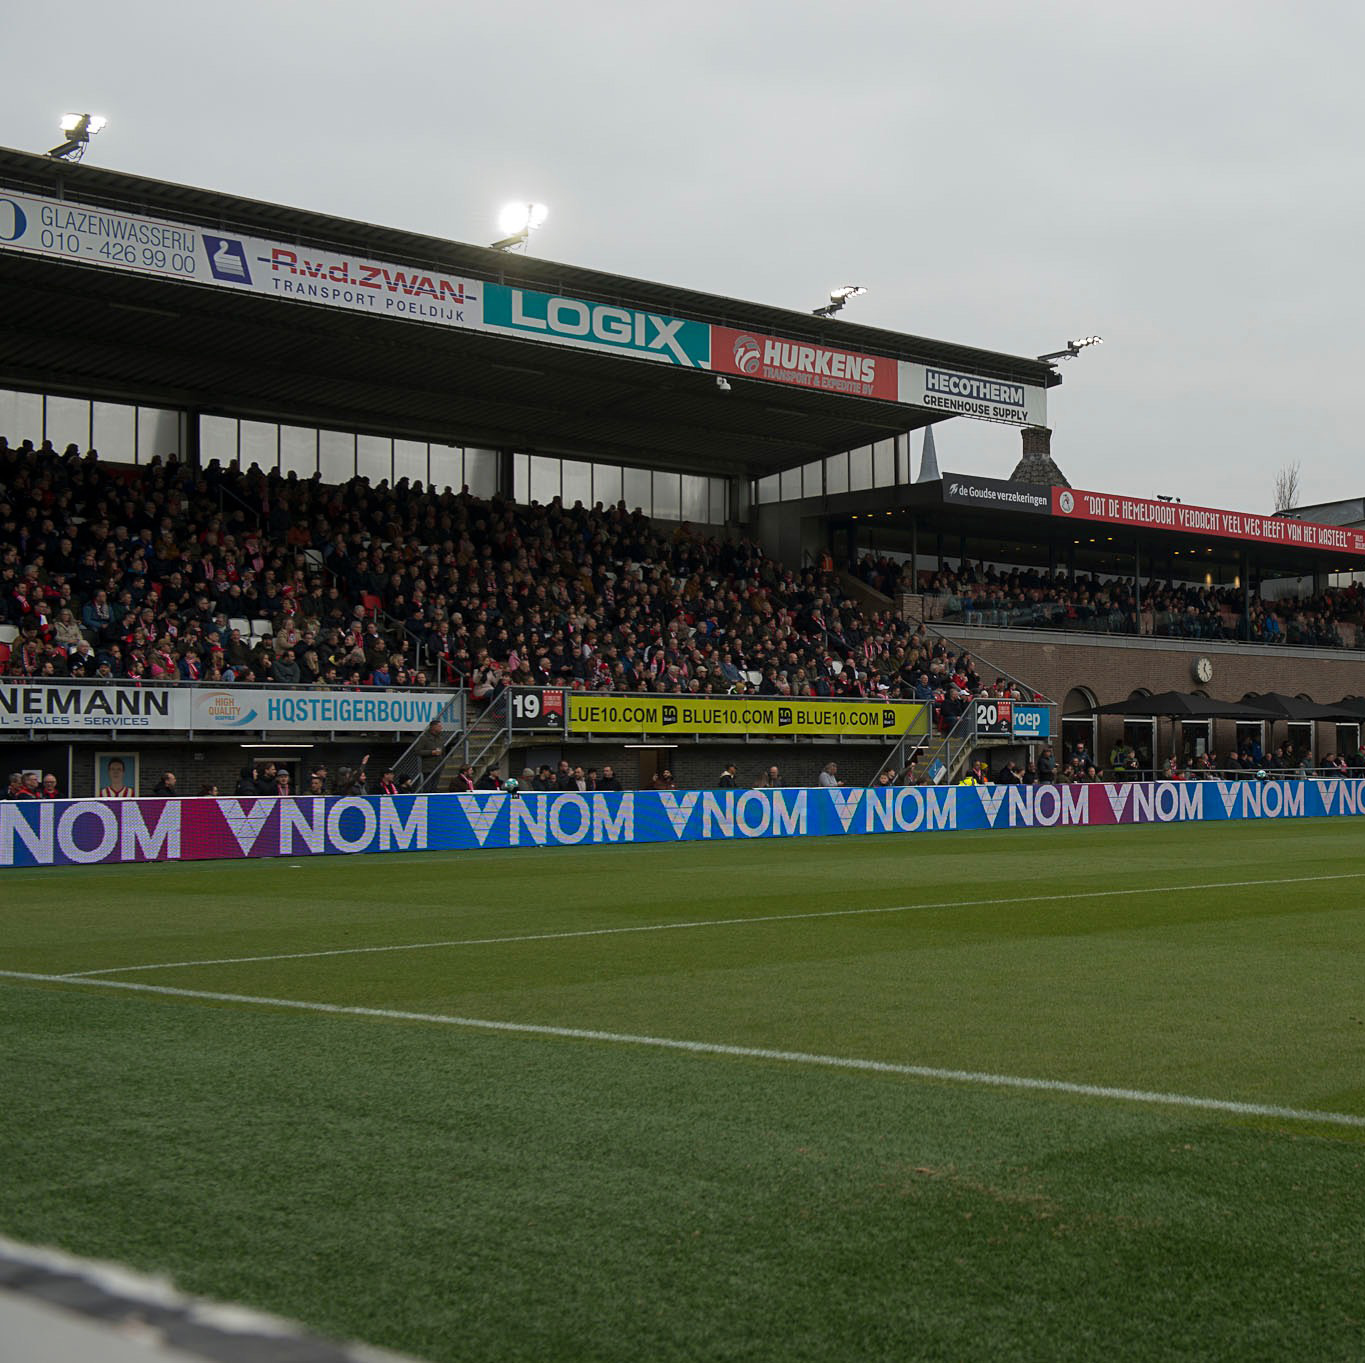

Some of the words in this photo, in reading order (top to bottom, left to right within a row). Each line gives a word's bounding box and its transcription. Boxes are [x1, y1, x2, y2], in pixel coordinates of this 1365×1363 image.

[41, 206, 195, 253] GLAZENWASSERIJ
[41, 229, 80, 253] 010
[99, 241, 136, 263] 426
[142, 248, 166, 268] 99
[172, 253, 196, 274] 00
[272, 278, 376, 306] TRANSPORT
[386, 299, 465, 322] POELDIJK
[511, 289, 695, 367] LOGIX
[763, 340, 875, 383] HURKENS
[762, 366, 812, 386] TRANSPORT
[821, 376, 862, 393] EXPEDITIE
[926, 372, 1023, 405] HECOTHERM
[923, 394, 990, 416] GREENHOUSE
[992, 405, 1029, 422] SUPPLY
[959, 486, 968, 496] de
[969, 486, 997, 501] Goudse
[997, 491, 1047, 507] verzekeringen
[1108, 498, 1120, 518] DE
[1122, 499, 1175, 525] HEMELPOORT
[1178, 509, 1220, 531] VERDACHT
[1222, 514, 1241, 534] VEEL
[1244, 517, 1261, 536] WEG
[1263, 521, 1285, 540] HEEFT
[1287, 523, 1302, 542] VAN
[1303, 526, 1317, 544] HET
[0, 688, 169, 716] NEMANN
[208, 706, 241, 716] QUALITY
[215, 697, 235, 706] HIGH
[513, 694, 540, 719] 19
[683, 709, 774, 725] BLUE10.COM
[977, 705, 997, 725] 20
[24, 716, 70, 725] SALES
[81, 717, 149, 726] SERVICES
[797, 711, 879, 726] BLUE10.COM
[660, 790, 807, 839] VNOM
[976, 784, 1088, 827] VNOM
[1104, 782, 1203, 824] VNOM
[216, 796, 428, 857] VNOM
[457, 793, 634, 847] VNOM
